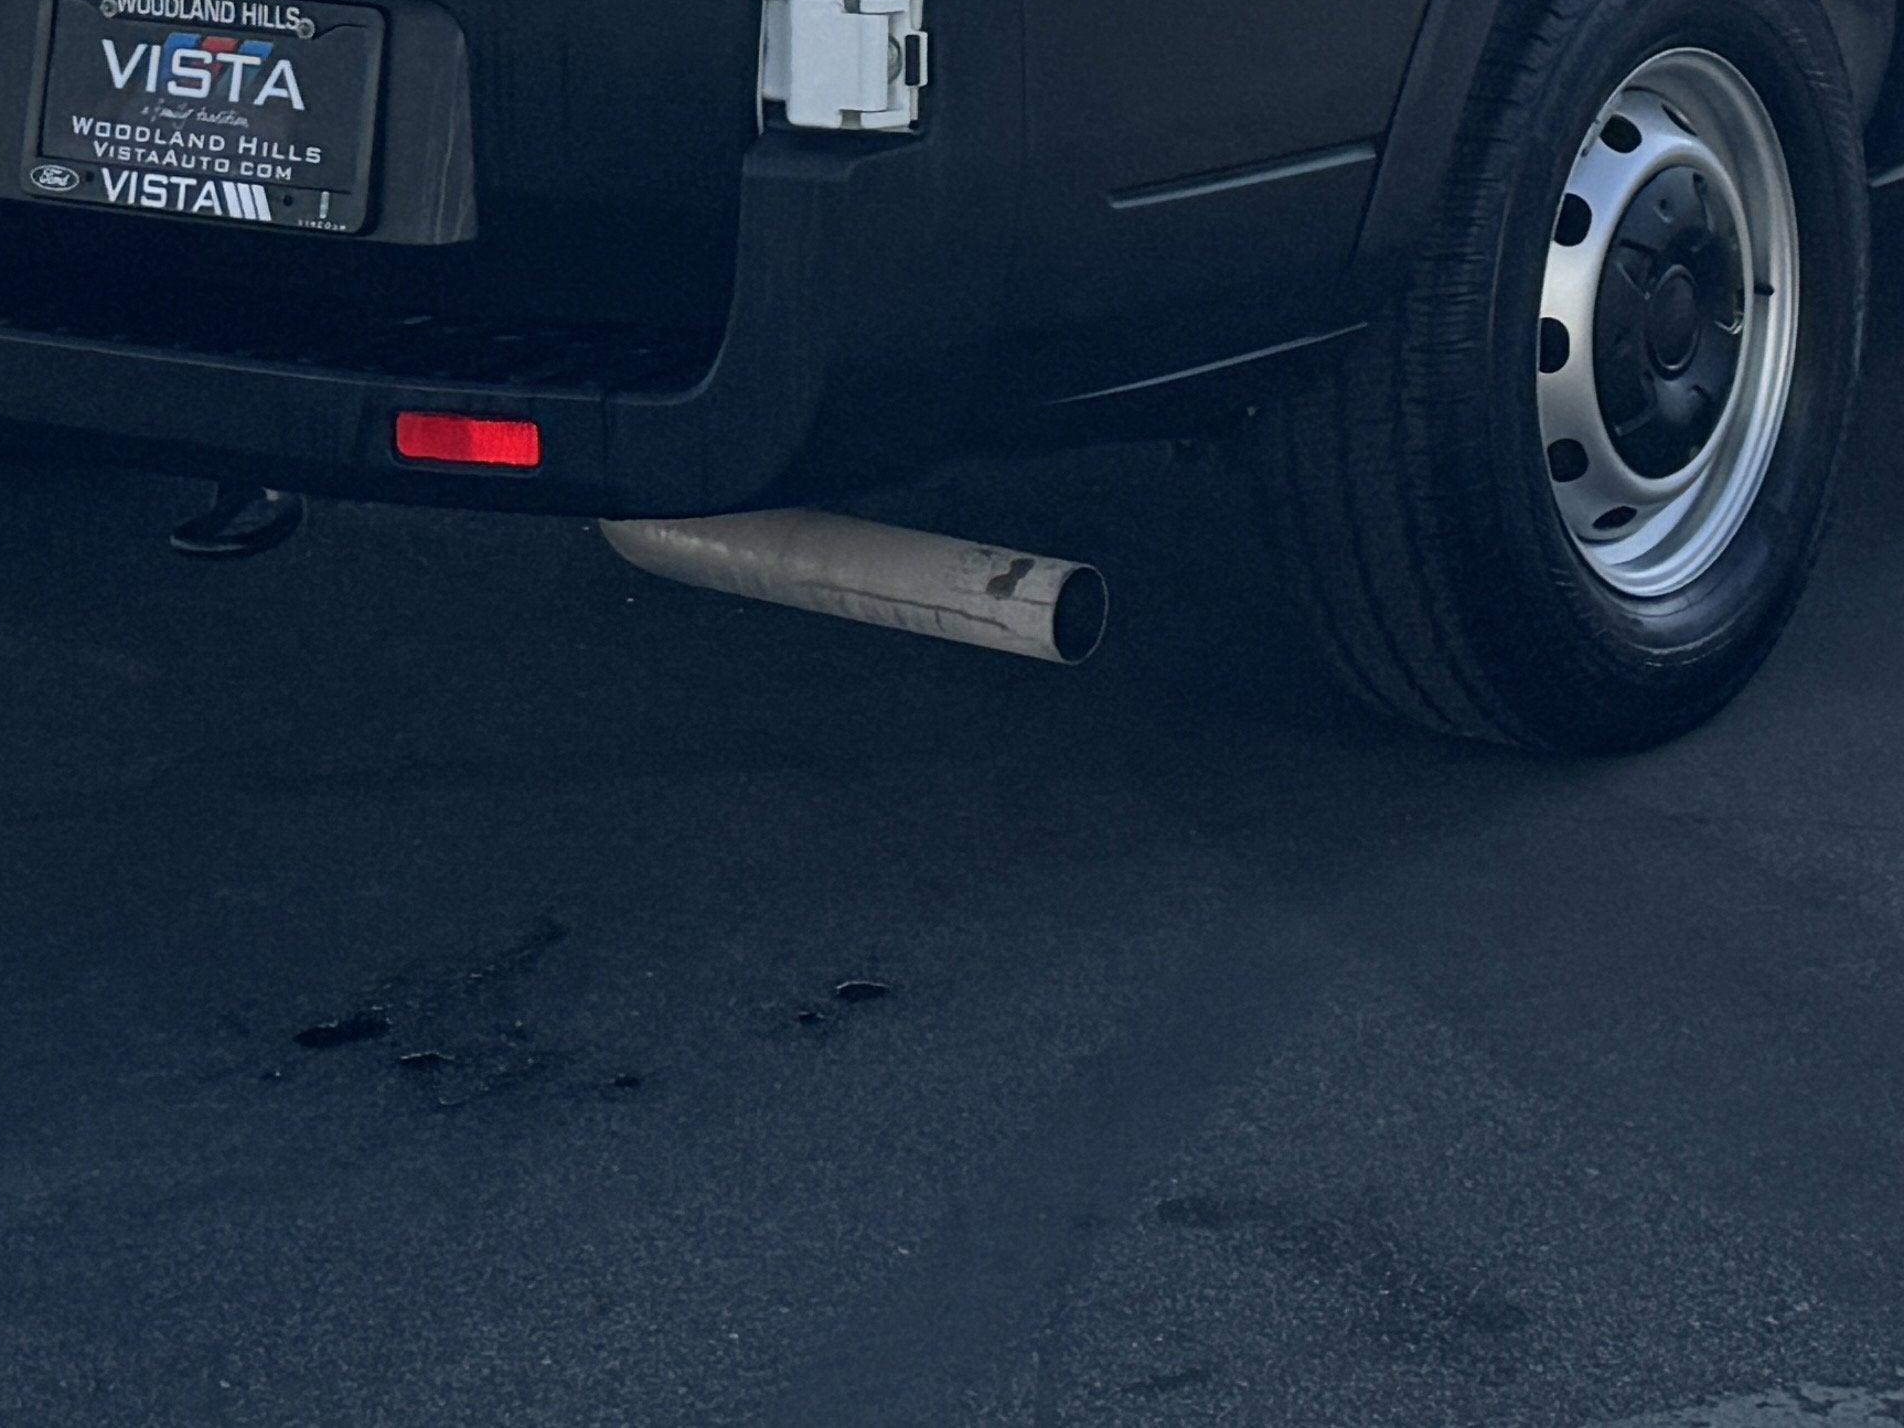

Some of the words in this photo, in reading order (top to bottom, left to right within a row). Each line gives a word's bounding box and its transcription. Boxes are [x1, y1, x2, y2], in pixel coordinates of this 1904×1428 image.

[241, 1, 301, 31] HILLS
[101, 38, 306, 111] VISTA
[72, 115, 227, 152] WOODLAND
[238, 135, 323, 164] HILLS
[39, 167, 71, 186] Ford
[101, 167, 224, 217] VISTA
